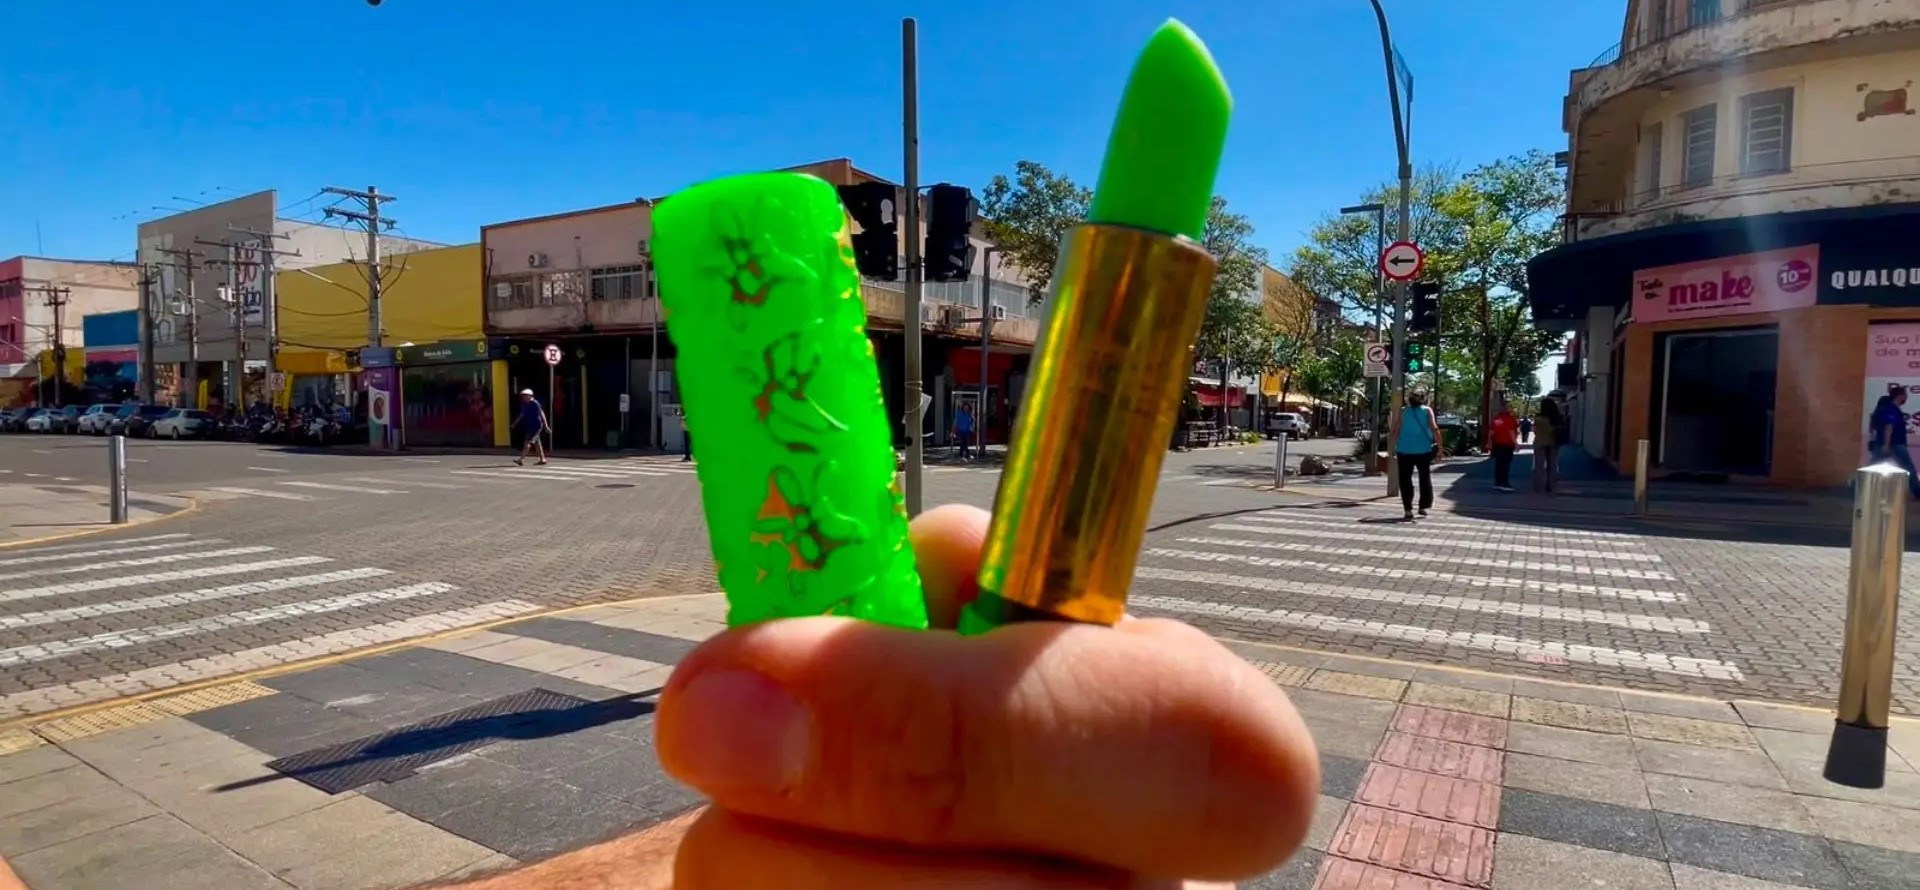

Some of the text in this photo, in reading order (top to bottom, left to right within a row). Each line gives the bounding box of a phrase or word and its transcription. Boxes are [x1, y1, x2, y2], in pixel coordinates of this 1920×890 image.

[1780, 270, 1799, 284] 10
[1668, 270, 1754, 306] make
[1874, 334, 1910, 345] Sua
[1875, 347, 1899, 357] de
